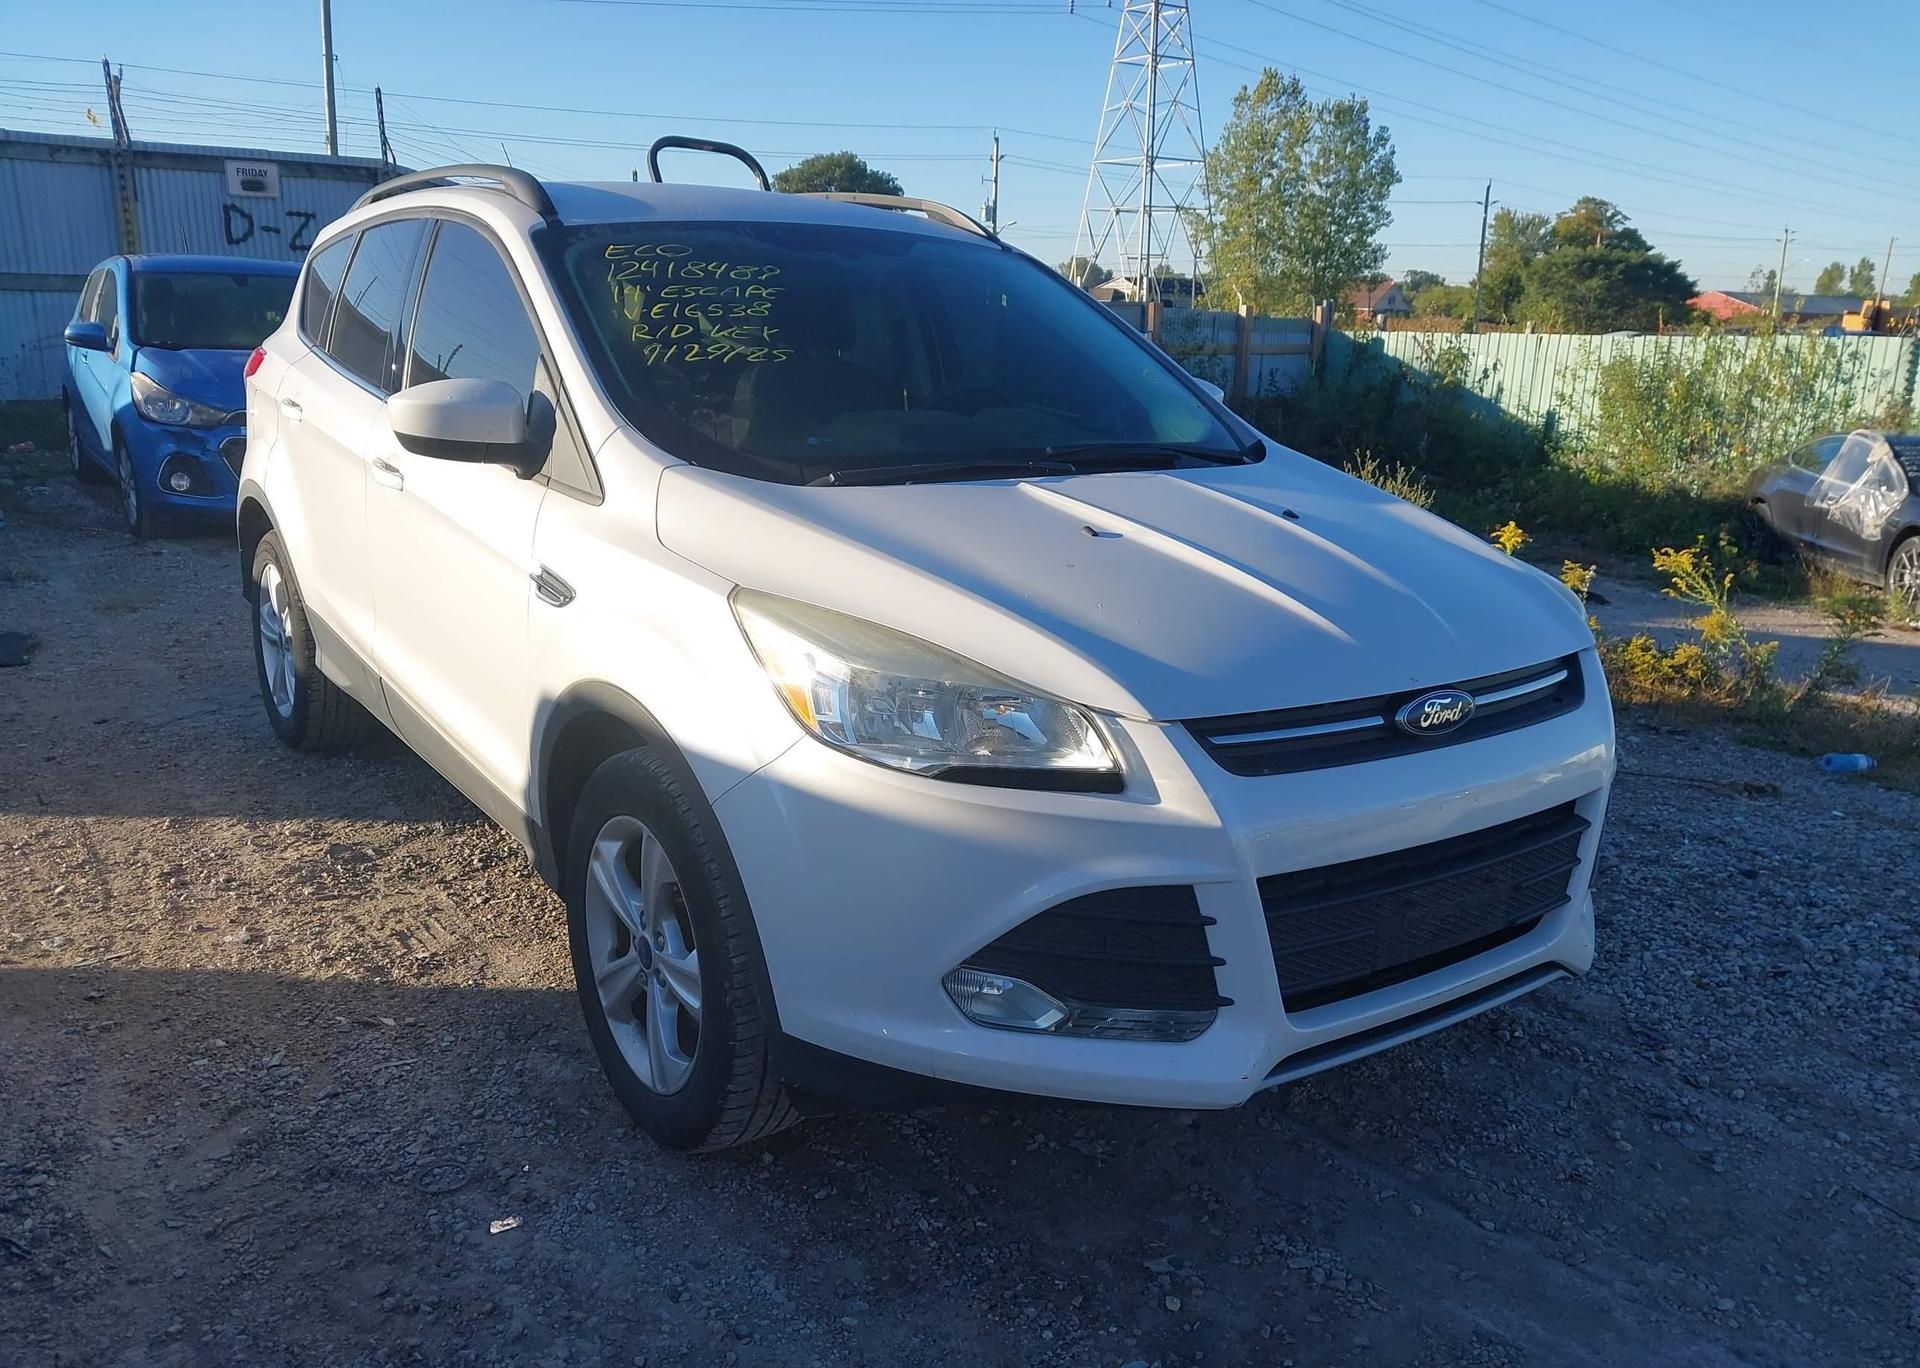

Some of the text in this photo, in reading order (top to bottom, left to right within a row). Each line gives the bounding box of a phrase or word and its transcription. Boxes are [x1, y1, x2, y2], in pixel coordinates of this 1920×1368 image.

[236, 167, 268, 177] FRIDAY
[605, 245, 693, 259] ECO
[661, 285, 785, 299] ESCAPE
[1421, 698, 1463, 728] Ford
